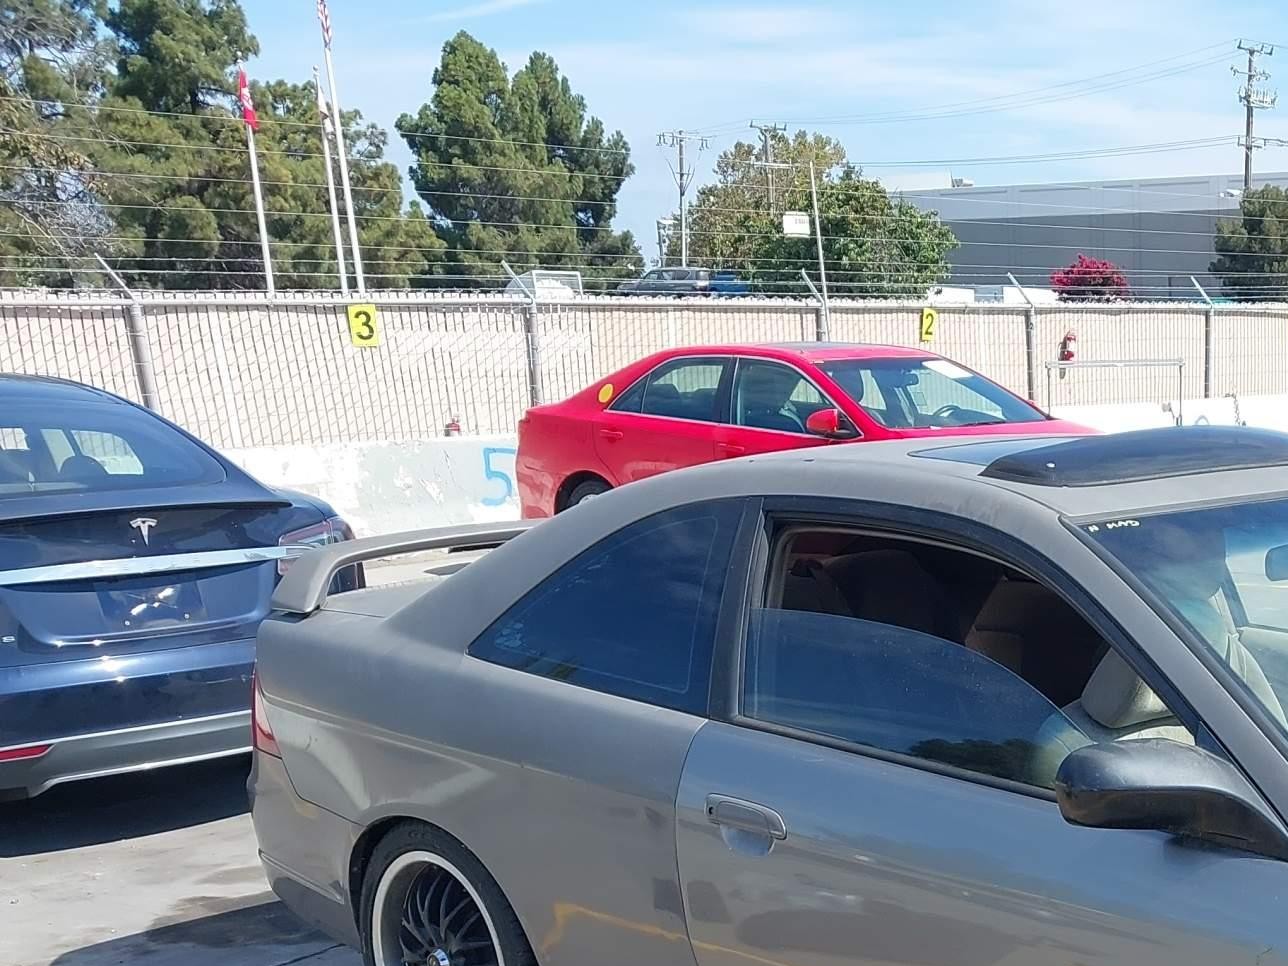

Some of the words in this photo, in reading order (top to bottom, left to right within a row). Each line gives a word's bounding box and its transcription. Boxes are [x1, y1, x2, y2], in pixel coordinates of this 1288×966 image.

[354, 310, 375, 340] 3
[924, 312, 935, 336] 2
[481, 447, 517, 506] 5
